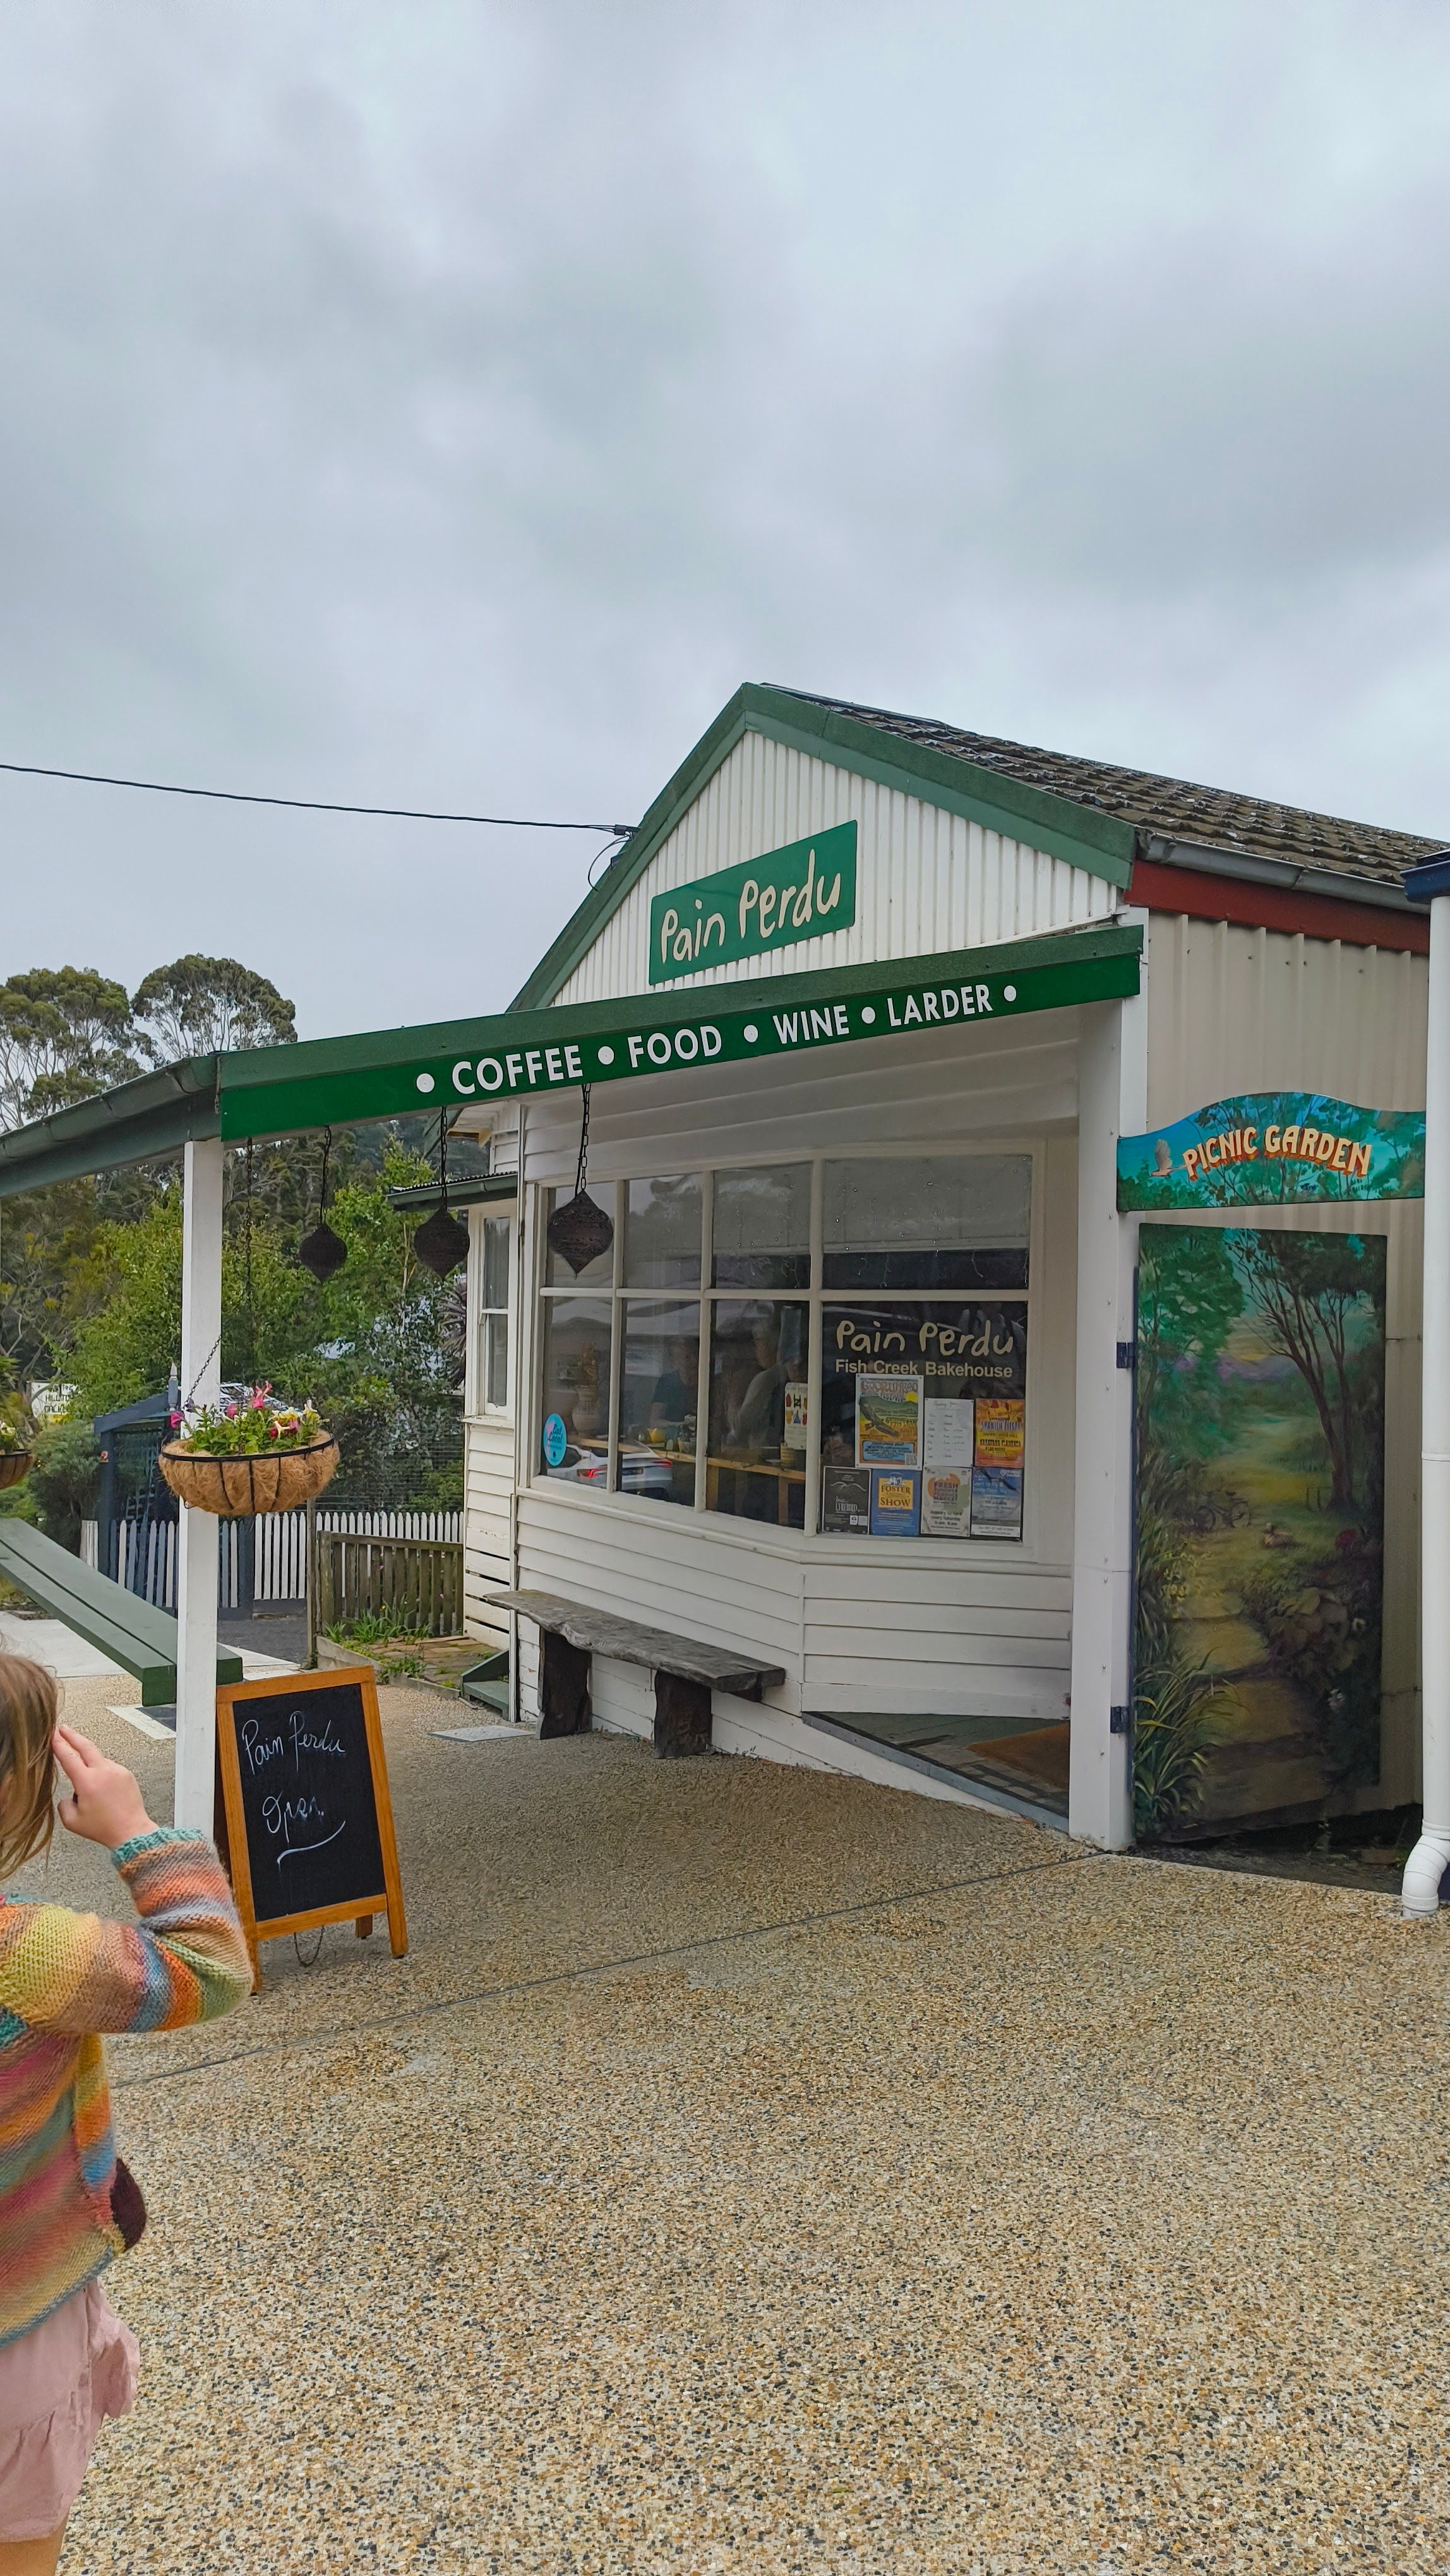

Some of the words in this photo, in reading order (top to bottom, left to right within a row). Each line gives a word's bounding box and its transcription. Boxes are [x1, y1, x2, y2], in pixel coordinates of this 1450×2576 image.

[661, 898, 726, 963] Pain
[738, 848, 841, 939] Perdu
[452, 1045, 584, 1095] COFFEE
[627, 1025, 722, 1068] FOOD
[772, 1005, 849, 1044] WINE
[887, 984, 994, 1027] LARDER
[1182, 1126, 1259, 1181] PICNIC
[1264, 1124, 1372, 1178] GARDEN
[836, 1320, 906, 1354] Pain
[919, 1319, 1014, 1356] Perdu
[836, 1359, 868, 1373] Fish
[873, 1359, 918, 1375] Creek
[925, 1361, 1013, 1378] Bakehouse
[880, 1497, 911, 1507] SHOW
[881, 1484, 911, 1494] FOSTER
[241, 1719, 284, 1775] Pain
[289, 1710, 346, 1772] Perdu
